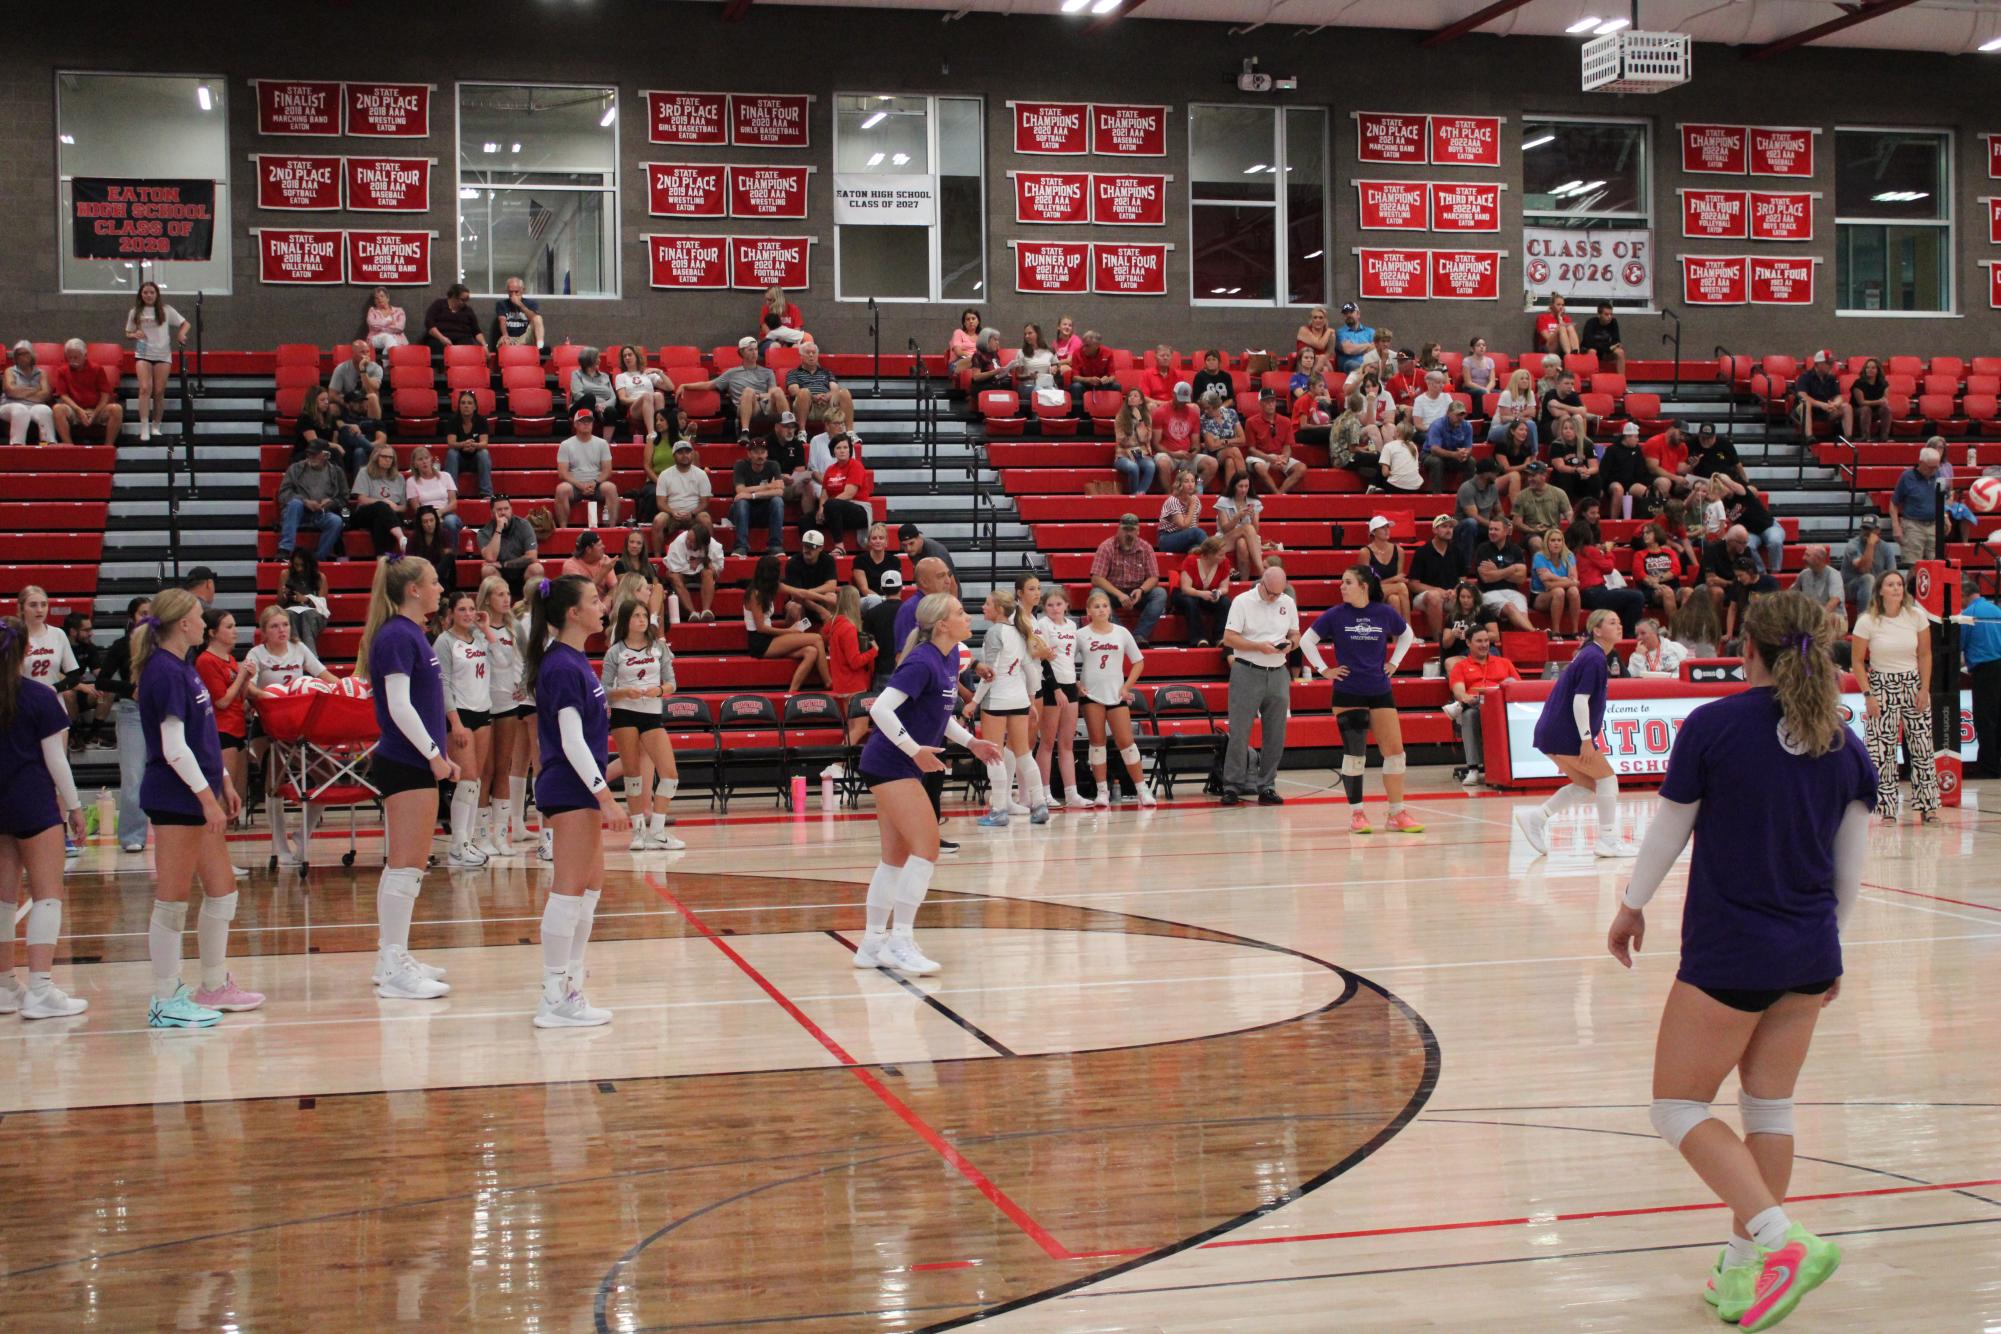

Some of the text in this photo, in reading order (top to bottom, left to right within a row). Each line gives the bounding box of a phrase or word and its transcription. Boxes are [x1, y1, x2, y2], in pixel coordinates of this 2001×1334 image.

[287, 87, 312, 95] STATE
[374, 88, 399, 96] STATE
[274, 91, 325, 109] FINALIST
[357, 94, 418, 111] 2ND PLACE
[660, 103, 718, 119] 3RD PLACE
[741, 105, 799, 121] FINAL FOUR
[1023, 113, 1078, 128] CHAMPIONS
[1101, 115, 1155, 131] CHAMPIONS
[1367, 123, 1418, 139] 2ND PLACE
[1440, 126, 1491, 141] 4TH PLACE
[1691, 134, 1740, 149] CHAMPIONS
[1757, 138, 1805, 152] CHAMPIONS
[287, 161, 312, 169] STATE
[270, 167, 331, 183] 2ND PLACE
[358, 168, 419, 185] FINAL FOUR
[674, 169, 698, 177] STATE
[302, 181, 318, 189] AAA
[370, 182, 406, 191] 2018 AAA
[657, 174, 716, 191] 2ND PLACE
[739, 176, 797, 192] CHAMPIONS
[1025, 182, 1080, 198] CHAMPIONS
[108, 186, 180, 202] EATON
[371, 191, 404, 199] BASEBALL
[836, 190, 868, 198] EATON
[1101, 184, 1155, 200] CHAMPIONS
[1368, 190, 1420, 205] CHAMPIONS
[1439, 193, 1493, 207] THIRD PLACE
[1691, 199, 1740, 215] FINAL FOUR
[77, 202, 210, 219] HIGH SCHOOL
[1757, 203, 1803, 216] 3RD PLACE
[94, 220, 194, 236] CLASS OF
[289, 235, 314, 243] STATE
[376, 236, 401, 244] STATE
[677, 241, 700, 249] STATE
[271, 241, 334, 257] FINAL FOUR
[359, 242, 420, 258] CHAMPIONS
[659, 246, 718, 263] FINAL FOUR
[741, 247, 799, 263] CHAMPIONS
[1527, 239, 1644, 258] CLASS OF
[304, 255, 321, 263] AAA
[374, 256, 405, 264] 2019 AA
[672, 260, 688, 268] 2019
[755, 261, 772, 269] 2020
[1025, 252, 1080, 268] RUNNER UP
[1102, 254, 1156, 269] FINAL FOUR
[1369, 259, 1420, 274] CHAMPIONS
[282, 263, 323, 271] VOLLEYBALL
[363, 264, 396, 272] MARCHING
[1440, 260, 1491, 274] CHAMPIONS
[1559, 264, 1613, 281] 2026
[1691, 266, 1740, 279] CHAMPIONS
[1755, 267, 1808, 281] FINAL FOUR
[1066, 644, 1072, 656] 5
[1090, 641, 1119, 651] Eaton
[32, 660, 50, 677] 22
[1100, 655, 1108, 669] 8
[476, 663, 485, 679] 14
[1607, 705, 1649, 713] elcome to
